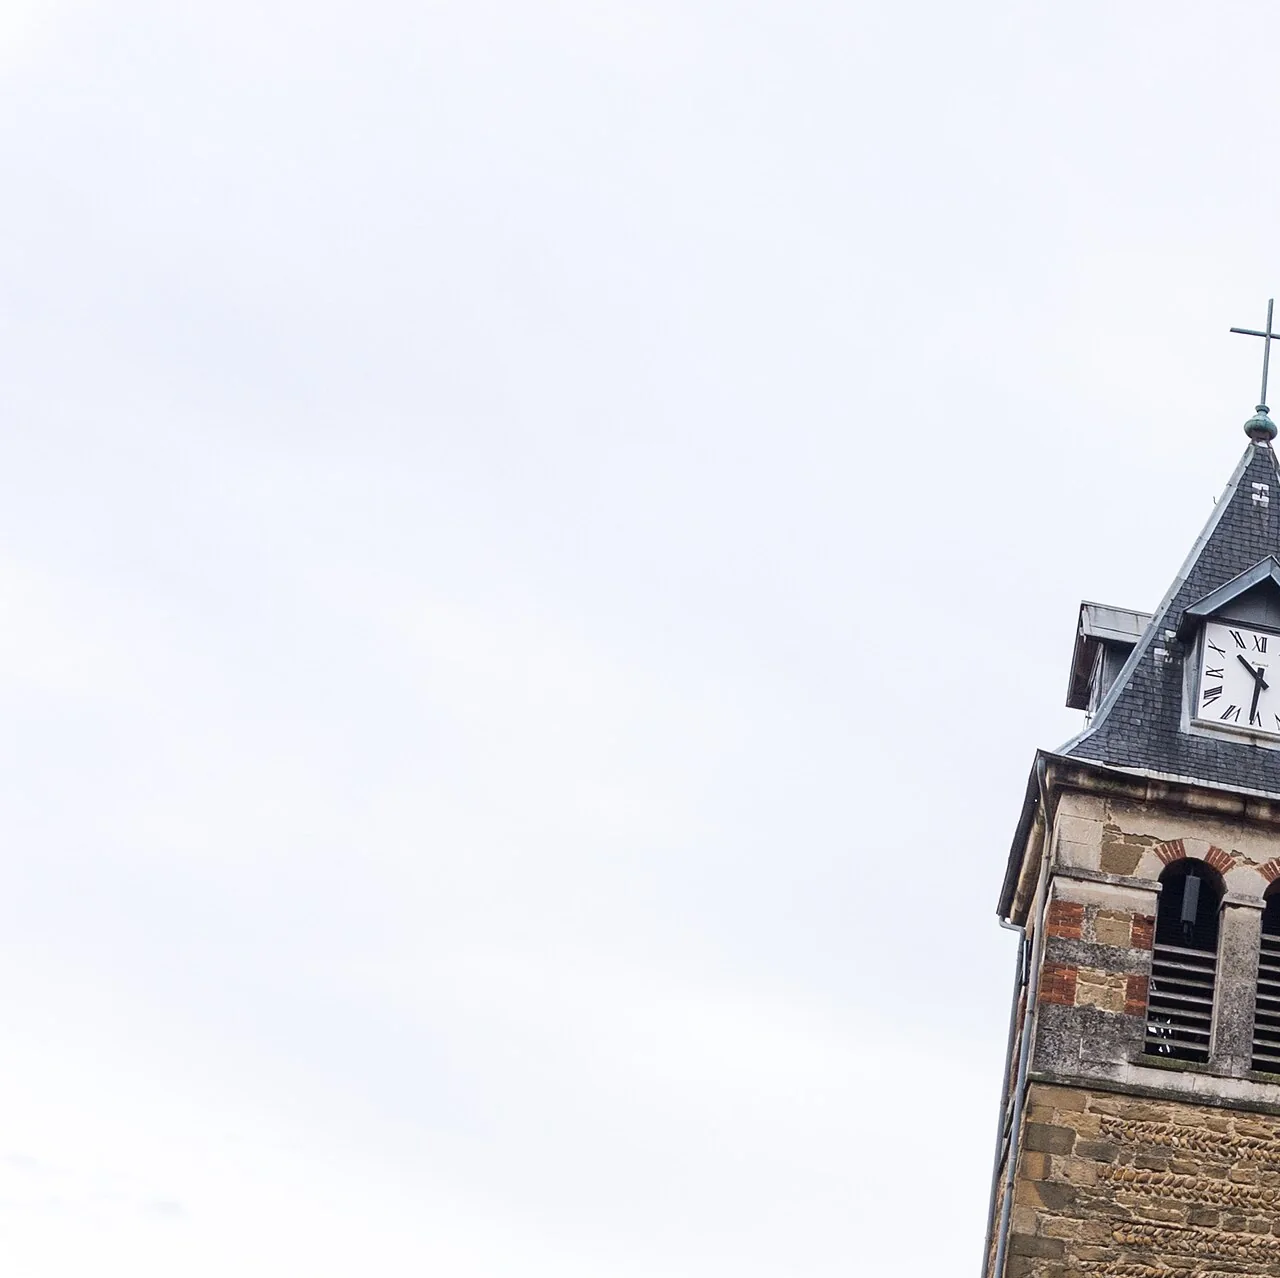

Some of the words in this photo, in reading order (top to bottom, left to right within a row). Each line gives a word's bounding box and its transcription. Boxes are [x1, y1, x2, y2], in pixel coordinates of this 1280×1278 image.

[1207, 638, 1226, 659] X
[1251, 634, 1268, 654] XII
[1205, 664, 1225, 679] IX
[1202, 685, 1223, 708] VIII
[1219, 704, 1242, 723] VII
